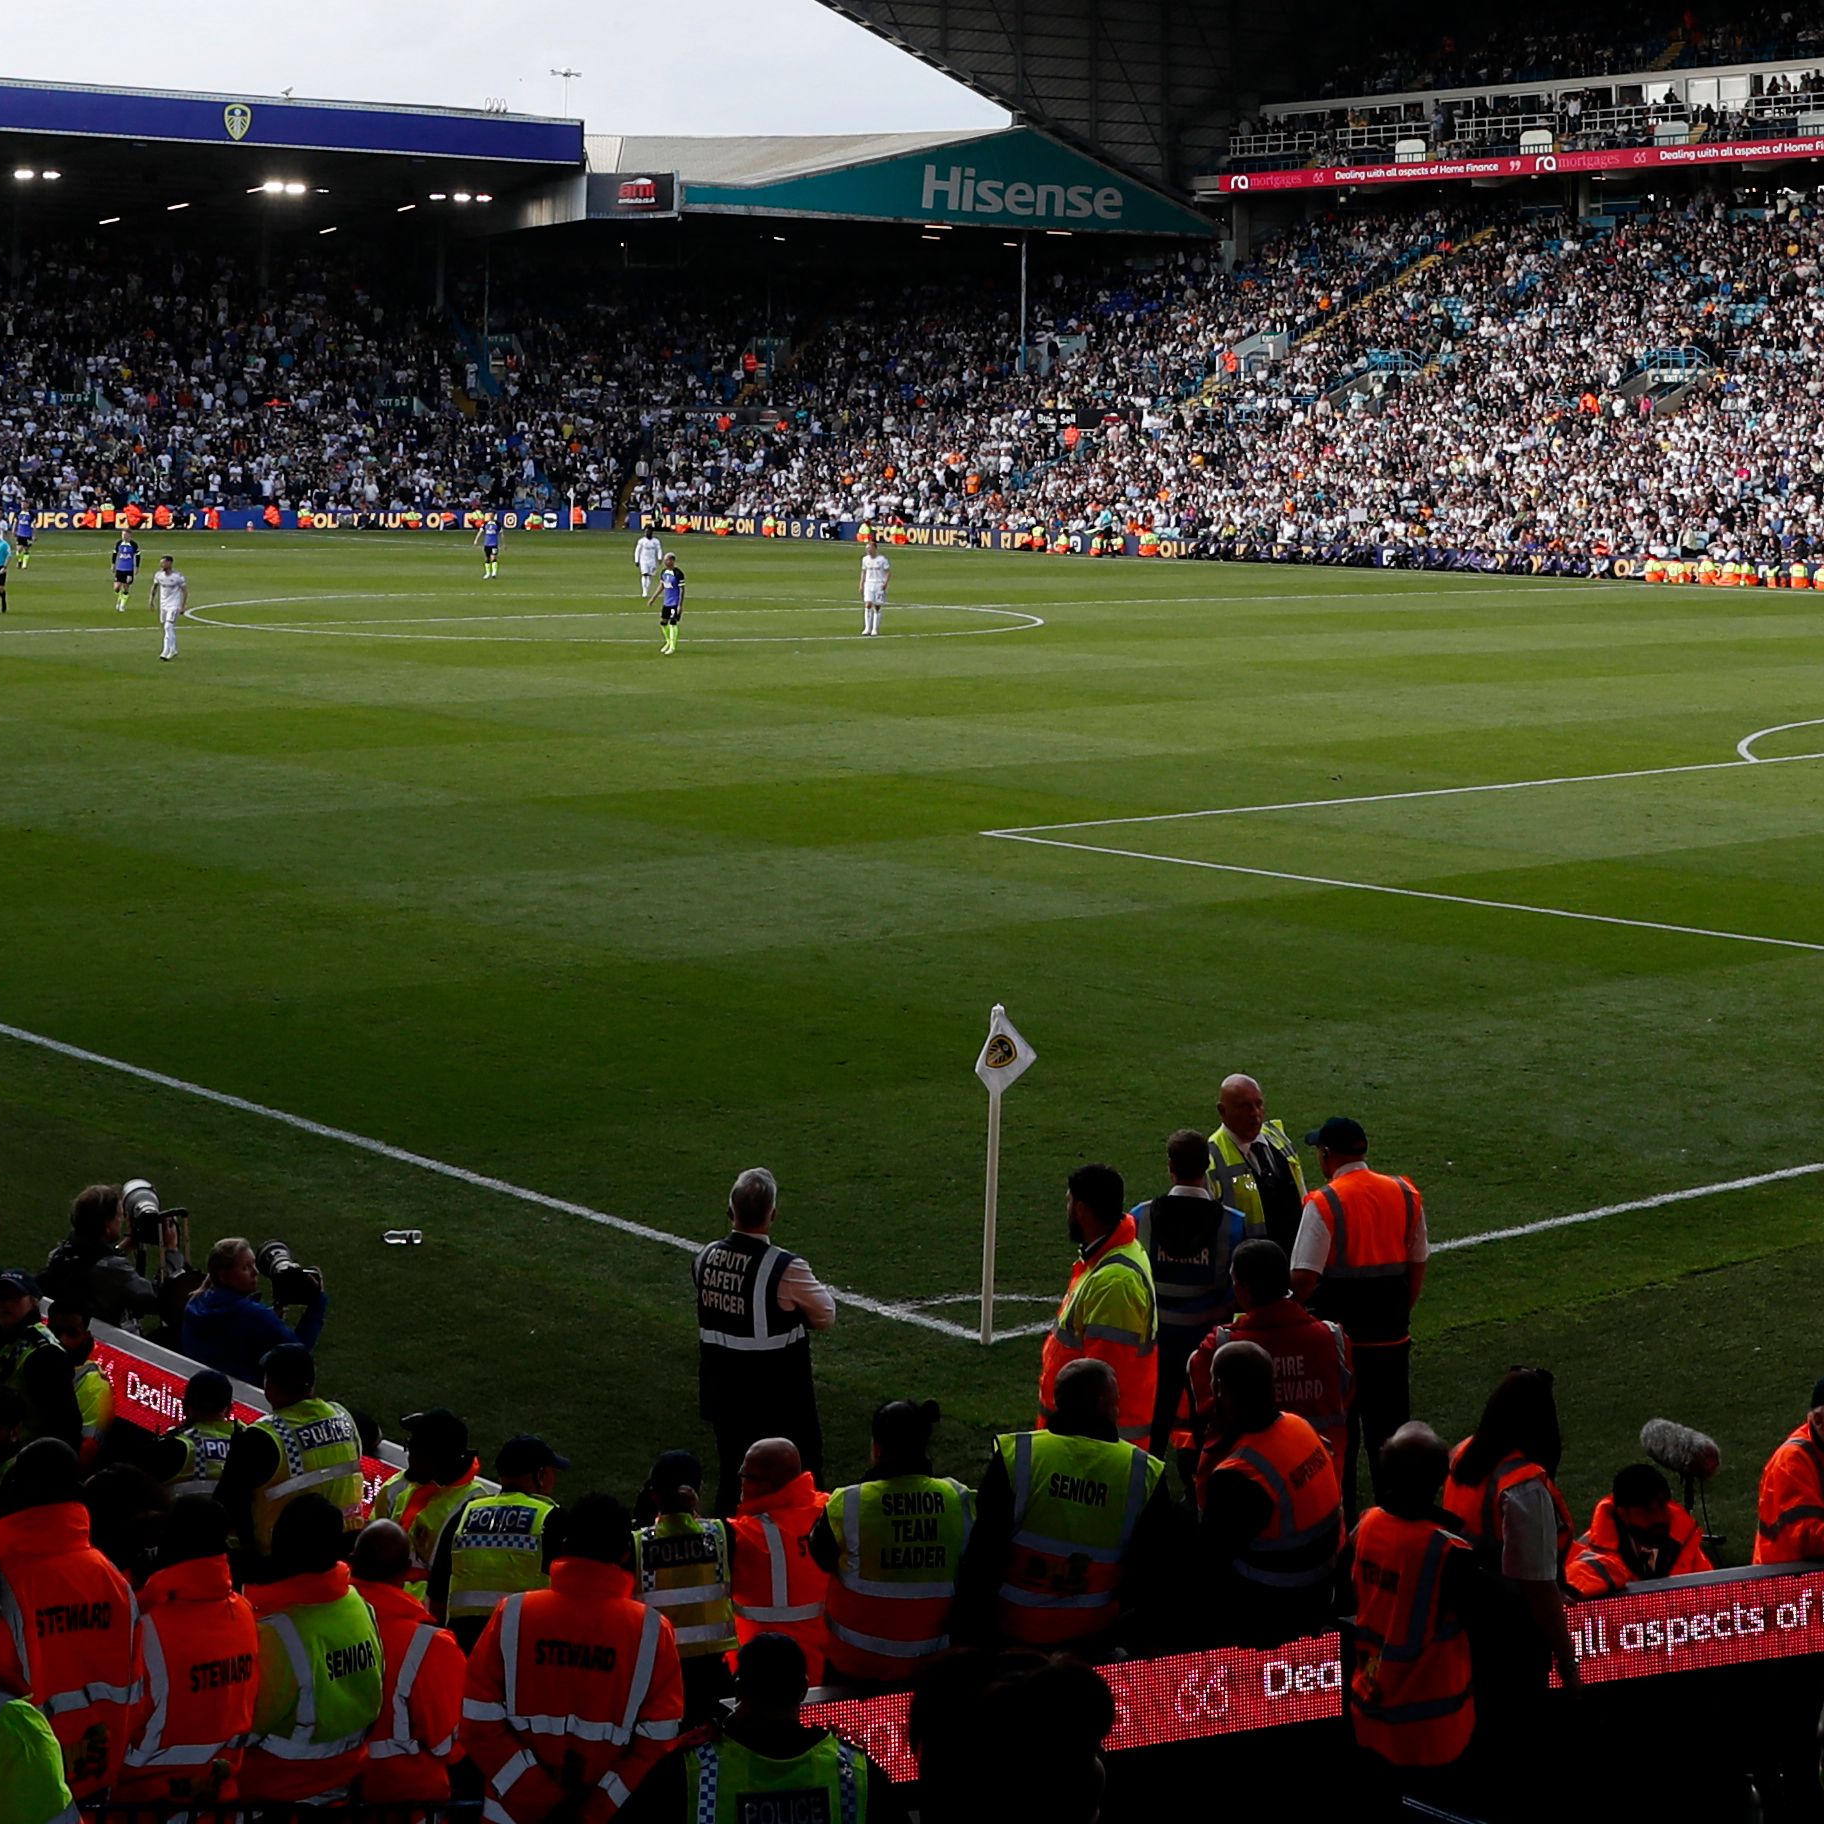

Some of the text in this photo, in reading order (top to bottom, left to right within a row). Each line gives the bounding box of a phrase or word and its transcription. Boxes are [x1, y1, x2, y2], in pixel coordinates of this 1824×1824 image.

[1558, 154, 1620, 168] mortgages
[1660, 150, 1695, 161] Dealing
[1697, 149, 1718, 158] with
[1720, 148, 1733, 156] all
[1735, 146, 1771, 157] aspects
[1773, 144, 1782, 153] of
[1784, 143, 1813, 152] Home
[1250, 174, 1302, 188] mortgages
[1335, 170, 1366, 180] Dealing
[1367, 169, 1385, 178] with
[1398, 168, 1428, 177] aspects
[1430, 166, 1438, 174] of
[1440, 165, 1464, 173] Home
[1466, 163, 1499, 172] Finance
[921, 164, 1123, 219] Hisense
[736, 518, 755, 534] ON
[876, 526, 930, 545] FOOW
[707, 1248, 752, 1273] DEPUTY
[703, 1266, 745, 1294] SAFETY
[702, 1289, 745, 1316] OFFICER
[127, 1371, 186, 1422] Dealin
[1274, 1378, 1324, 1406] EWARD
[881, 1491, 946, 1516] SENIOR
[1049, 1472, 1108, 1509] SENIOR
[468, 1510, 529, 1529] POLICE
[891, 1518, 939, 1543] TEAM
[880, 1546, 947, 1569] LEADER
[36, 1602, 110, 1638] STEWARD
[1619, 1601, 1764, 1657] aspects
[1776, 1590, 1813, 1629] of
[325, 1640, 375, 1680] SENIOR
[536, 1639, 615, 1674] STEWARD
[190, 1653, 253, 1694] STEWARD
